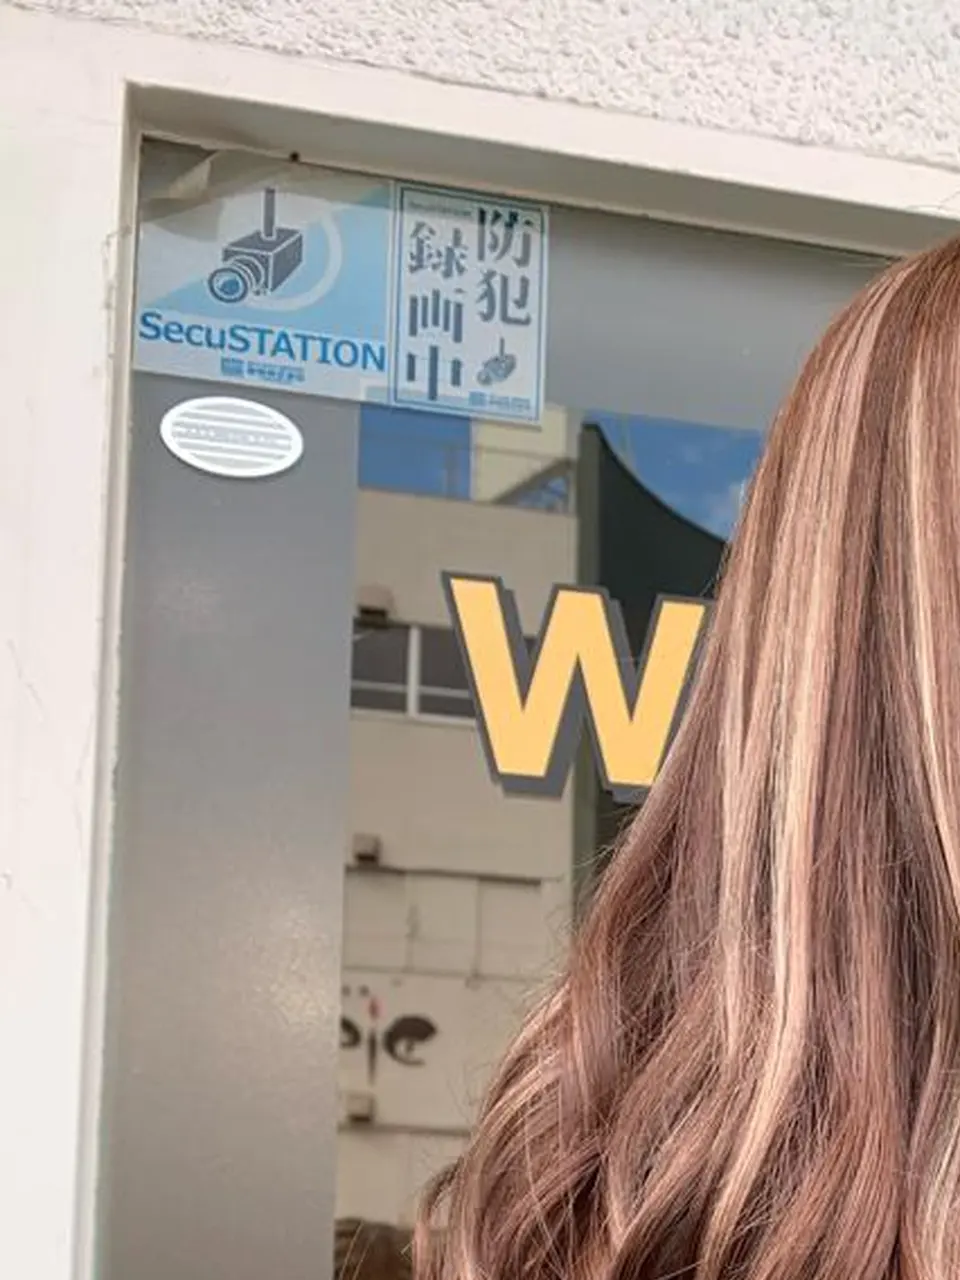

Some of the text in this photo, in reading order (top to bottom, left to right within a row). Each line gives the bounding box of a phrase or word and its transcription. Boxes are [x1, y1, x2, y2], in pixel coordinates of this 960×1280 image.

[408, 221, 470, 401] 録画中
[477, 206, 533, 328] 防犯
[138, 312, 387, 372] SecuSTATION
